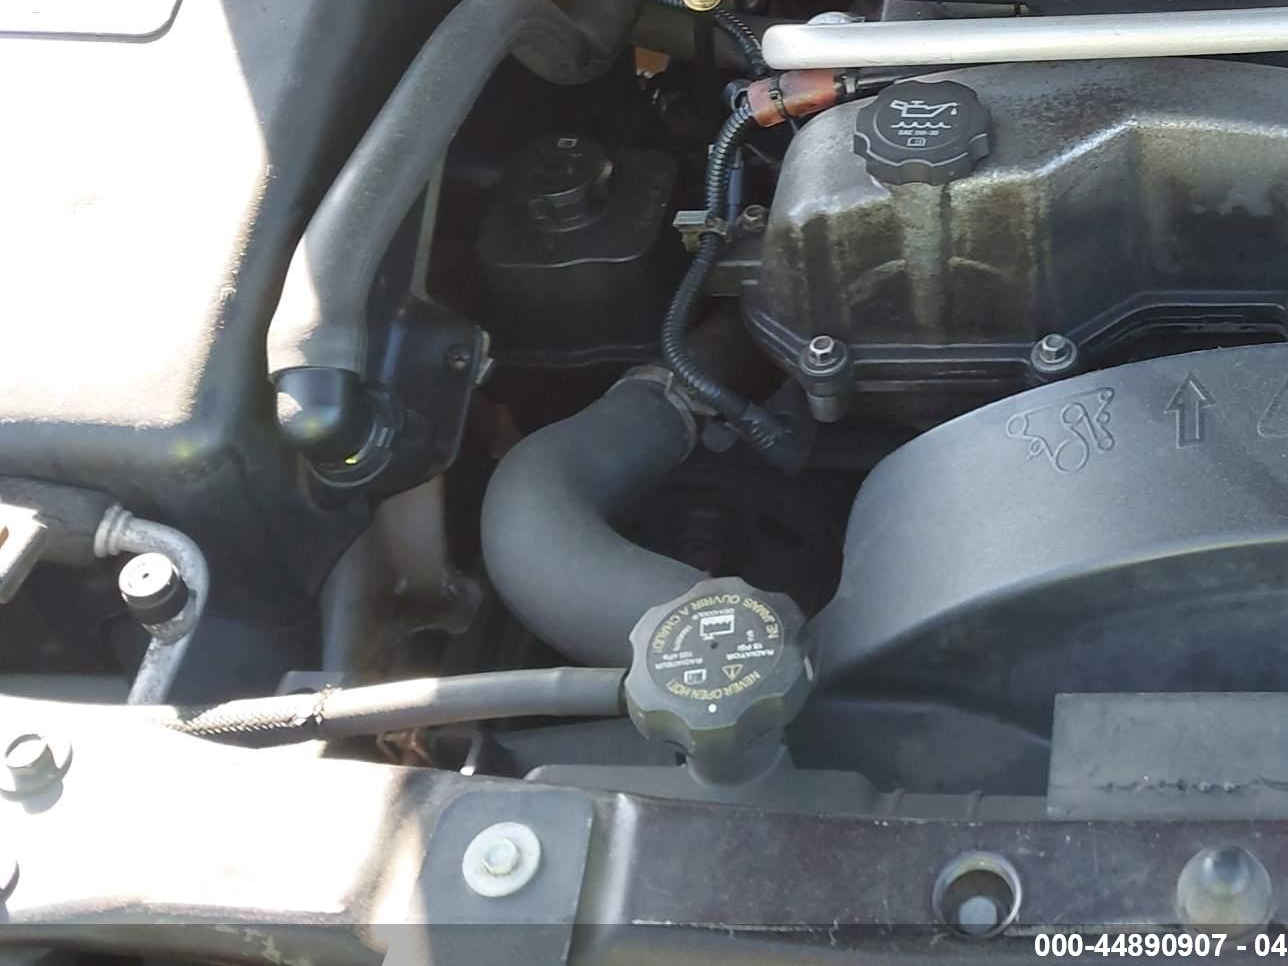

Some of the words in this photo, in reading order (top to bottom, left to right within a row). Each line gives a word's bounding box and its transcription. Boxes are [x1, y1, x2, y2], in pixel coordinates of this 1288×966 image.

[690, 593, 741, 610] OUVRIR
[725, 649, 775, 661] RADIATOR
[723, 670, 761, 696] NEVER
[690, 688, 723, 700] OPEN
